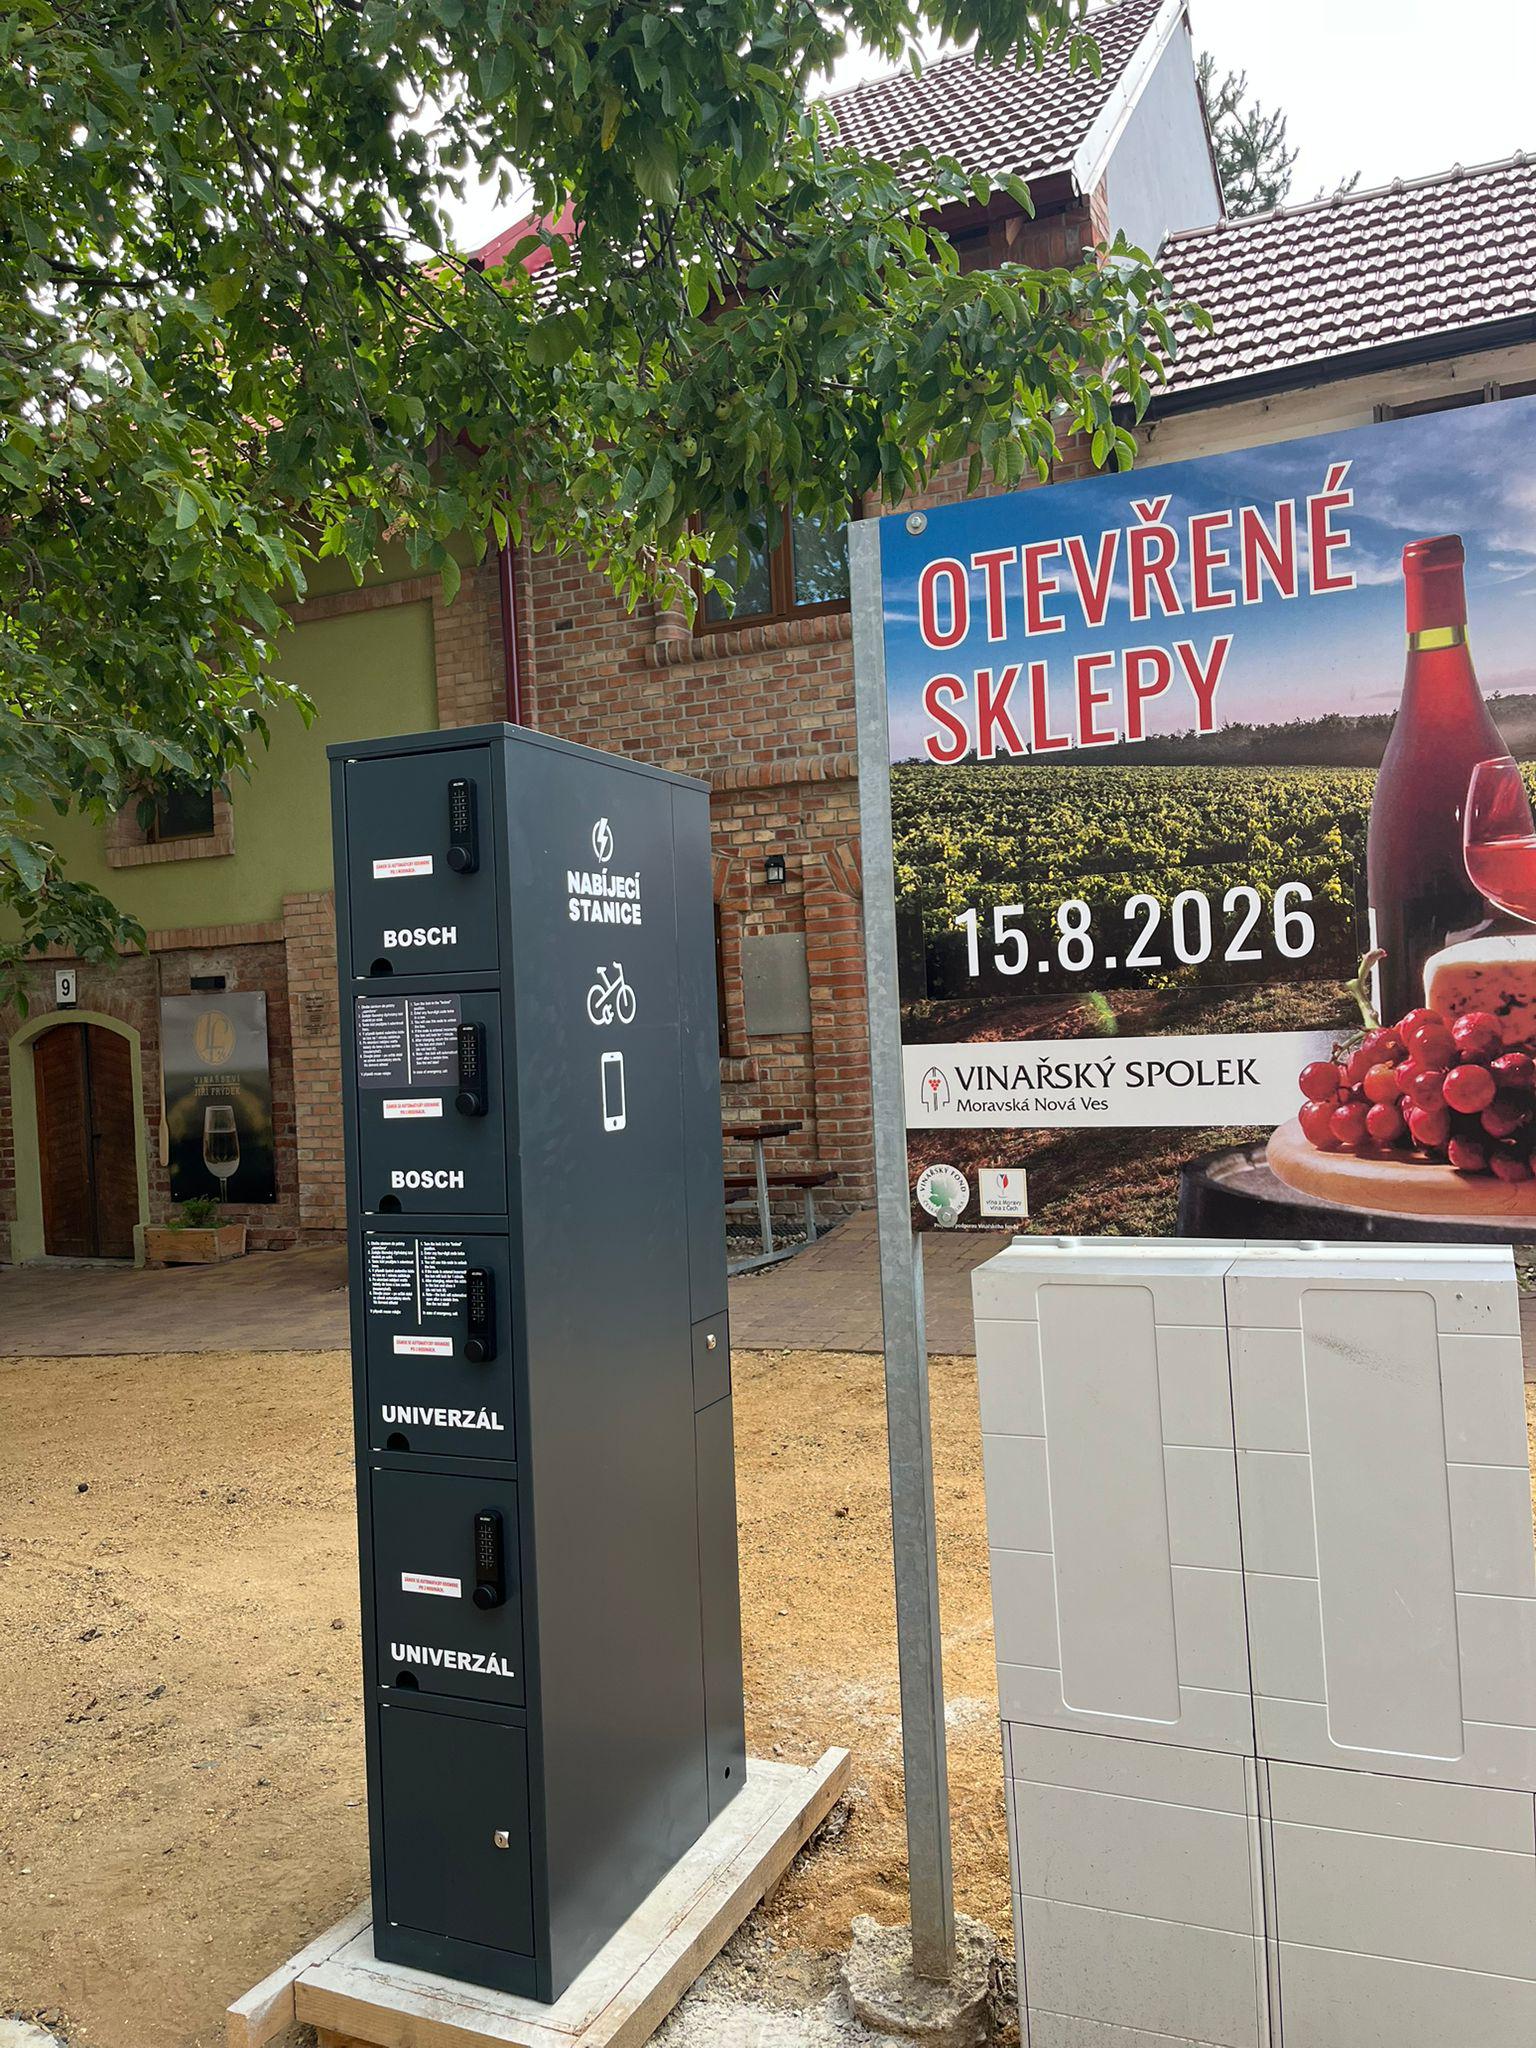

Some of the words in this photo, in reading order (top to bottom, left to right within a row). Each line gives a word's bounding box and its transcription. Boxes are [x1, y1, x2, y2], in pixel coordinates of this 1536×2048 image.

[918, 460, 1358, 650] OTEVŘENÉ
[922, 634, 1234, 765] SKLEPY
[567, 867, 641, 900] NABÍJECÍ
[568, 897, 642, 925] STANICE
[383, 926, 458, 949] BOSCH
[955, 881, 1317, 978] 15.8.2026
[61, 978, 70, 996] 9
[954, 1055, 1116, 1091] VINAŘSKÝ
[1125, 1058, 1261, 1088] SPOLEK
[956, 1098, 1030, 1113] Moravská
[1034, 1097, 1076, 1111] Nová
[1079, 1096, 1109, 1111] Ves
[391, 1170, 465, 1190] BOSCH
[950, 1170, 967, 1192] FOND
[381, 1404, 504, 1431] UNIVERZÁL
[390, 1641, 515, 1678] UNIVERZÁL
